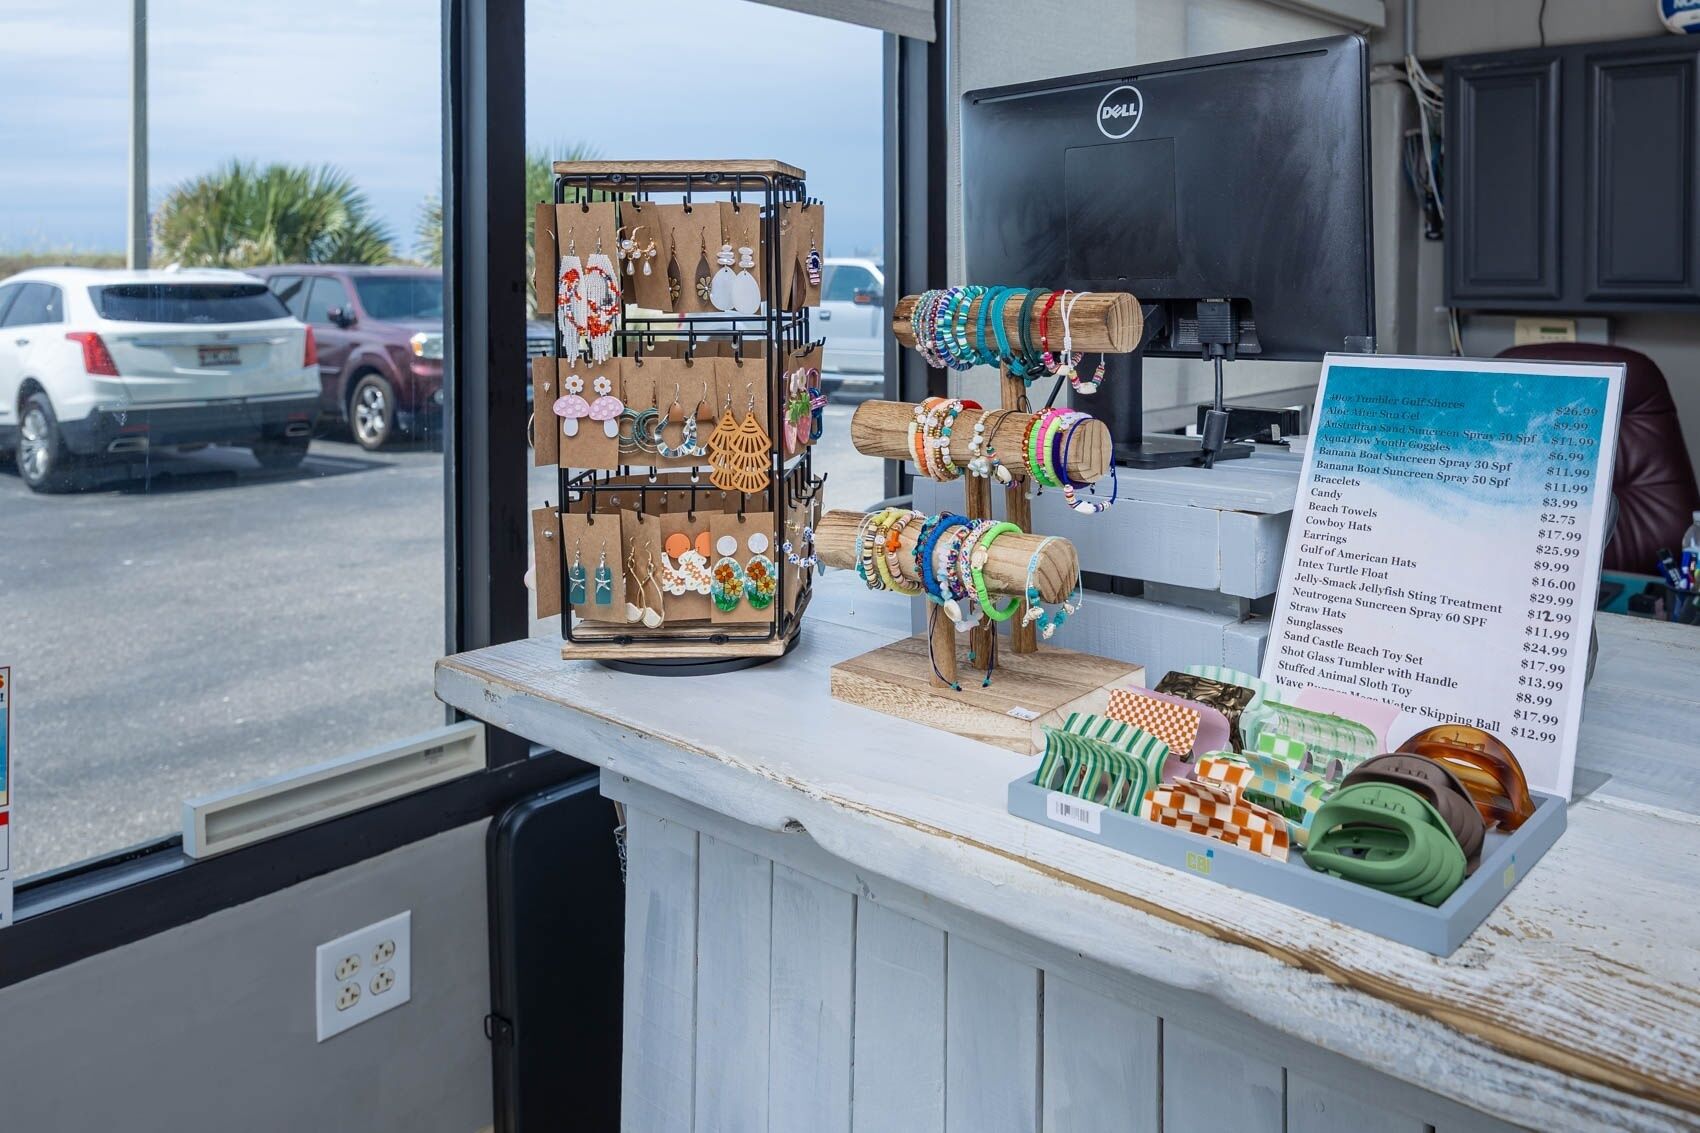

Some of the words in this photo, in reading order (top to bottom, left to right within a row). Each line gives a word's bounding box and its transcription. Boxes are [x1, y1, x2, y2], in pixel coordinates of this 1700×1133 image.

[1102, 103, 1137, 119] DELL
[1327, 406, 1349, 415] Aloe
[1380, 410, 1399, 418] Sun
[1401, 411, 1420, 420] Gel
[1553, 422, 1588, 432] $9.99
[1427, 400, 1465, 409] Shores
[1555, 406, 1598, 417] $26.99
[1324, 420, 1376, 432] Australian
[1379, 422, 1405, 433] Sand
[1463, 430, 1494, 442] Spray
[1498, 432, 1512, 441] 50
[1516, 434, 1537, 444] Spf
[1551, 436, 1594, 447] $11.99
[1374, 436, 1406, 447] Youth
[1408, 438, 1450, 452] Goggles
[1548, 452, 1584, 462] $6.99
[1316, 460, 1354, 472] Banana
[1357, 464, 1380, 474] Boat
[1382, 466, 1434, 479] Suncreen
[1436, 472, 1470, 485] Spray
[1472, 475, 1486, 484] 50
[1489, 476, 1510, 488] Spf
[1544, 482, 1588, 494] $11.99
[1319, 447, 1356, 458] Banana
[1360, 448, 1382, 460] Boat
[1384, 453, 1436, 464] Suncreen
[1438, 457, 1472, 470] Spray
[1474, 460, 1488, 470] 30
[1491, 462, 1512, 473] Spf
[1546, 466, 1590, 478] $11.99
[1311, 488, 1343, 500] Candy
[1540, 512, 1576, 526] $2.75
[1314, 474, 1360, 486] Bracelets
[1542, 497, 1578, 509] $3.99
[1306, 516, 1346, 529] Cowboy
[1348, 521, 1372, 532] Hats
[1536, 544, 1580, 558] $25.99
[1308, 502, 1338, 513] Beach
[1341, 505, 1378, 518] Towels
[1538, 528, 1582, 542] $17.99
[1300, 544, 1324, 554] Gulf
[1325, 548, 1336, 556] of
[1337, 549, 1388, 564] American
[1391, 556, 1417, 568] Hats
[1532, 576, 1576, 591] $16.00
[1304, 530, 1348, 544] Earrings
[1534, 560, 1570, 573] $9.99
[1294, 573, 1356, 590] Jelly-Smack
[1358, 582, 1405, 597] Jellyfish
[1407, 590, 1438, 604] Sting
[1440, 595, 1503, 614] Treatment
[1528, 609, 1572, 624] $12.99
[1298, 558, 1324, 570] Intex
[1327, 562, 1359, 576] Turtle
[1361, 567, 1388, 580] Float
[1530, 592, 1574, 608] $29.99
[1289, 602, 1320, 615] Straw
[1322, 606, 1347, 619] Hats
[1523, 642, 1568, 658] $24.99
[1292, 587, 1352, 604] Neutrogena
[1355, 598, 1407, 614] Suncreen
[1409, 606, 1444, 622] Spray
[1446, 613, 1460, 623] 60
[1463, 616, 1487, 628] SPF
[1525, 626, 1570, 641] $11.99
[1284, 630, 1310, 644] Sand
[1312, 636, 1344, 650] Castle
[1347, 642, 1379, 657] Beach
[1382, 648, 1403, 662] Toy
[1404, 654, 1424, 666] Set
[1518, 675, 1564, 692] $13.99
[1286, 616, 1344, 634] Sunglasses
[1521, 658, 1566, 675] $17.99
[1278, 660, 1316, 676] Stuffed
[1317, 668, 1357, 684] Animal
[1359, 676, 1388, 692] Sloth
[1391, 683, 1413, 698] Toy
[1514, 708, 1559, 726] $17.99
[1280, 645, 1304, 658] Shot
[1307, 650, 1335, 664] Glass
[1338, 656, 1385, 674] Tumbler
[1388, 668, 1412, 680] with
[1415, 672, 1458, 690] Handle
[1516, 692, 1553, 707] $8.99
[1275, 674, 1304, 689] Wave
[1419, 706, 1472, 727] Skipping
[1476, 718, 1500, 732] Ball
[1510, 726, 1556, 744] $12.99
